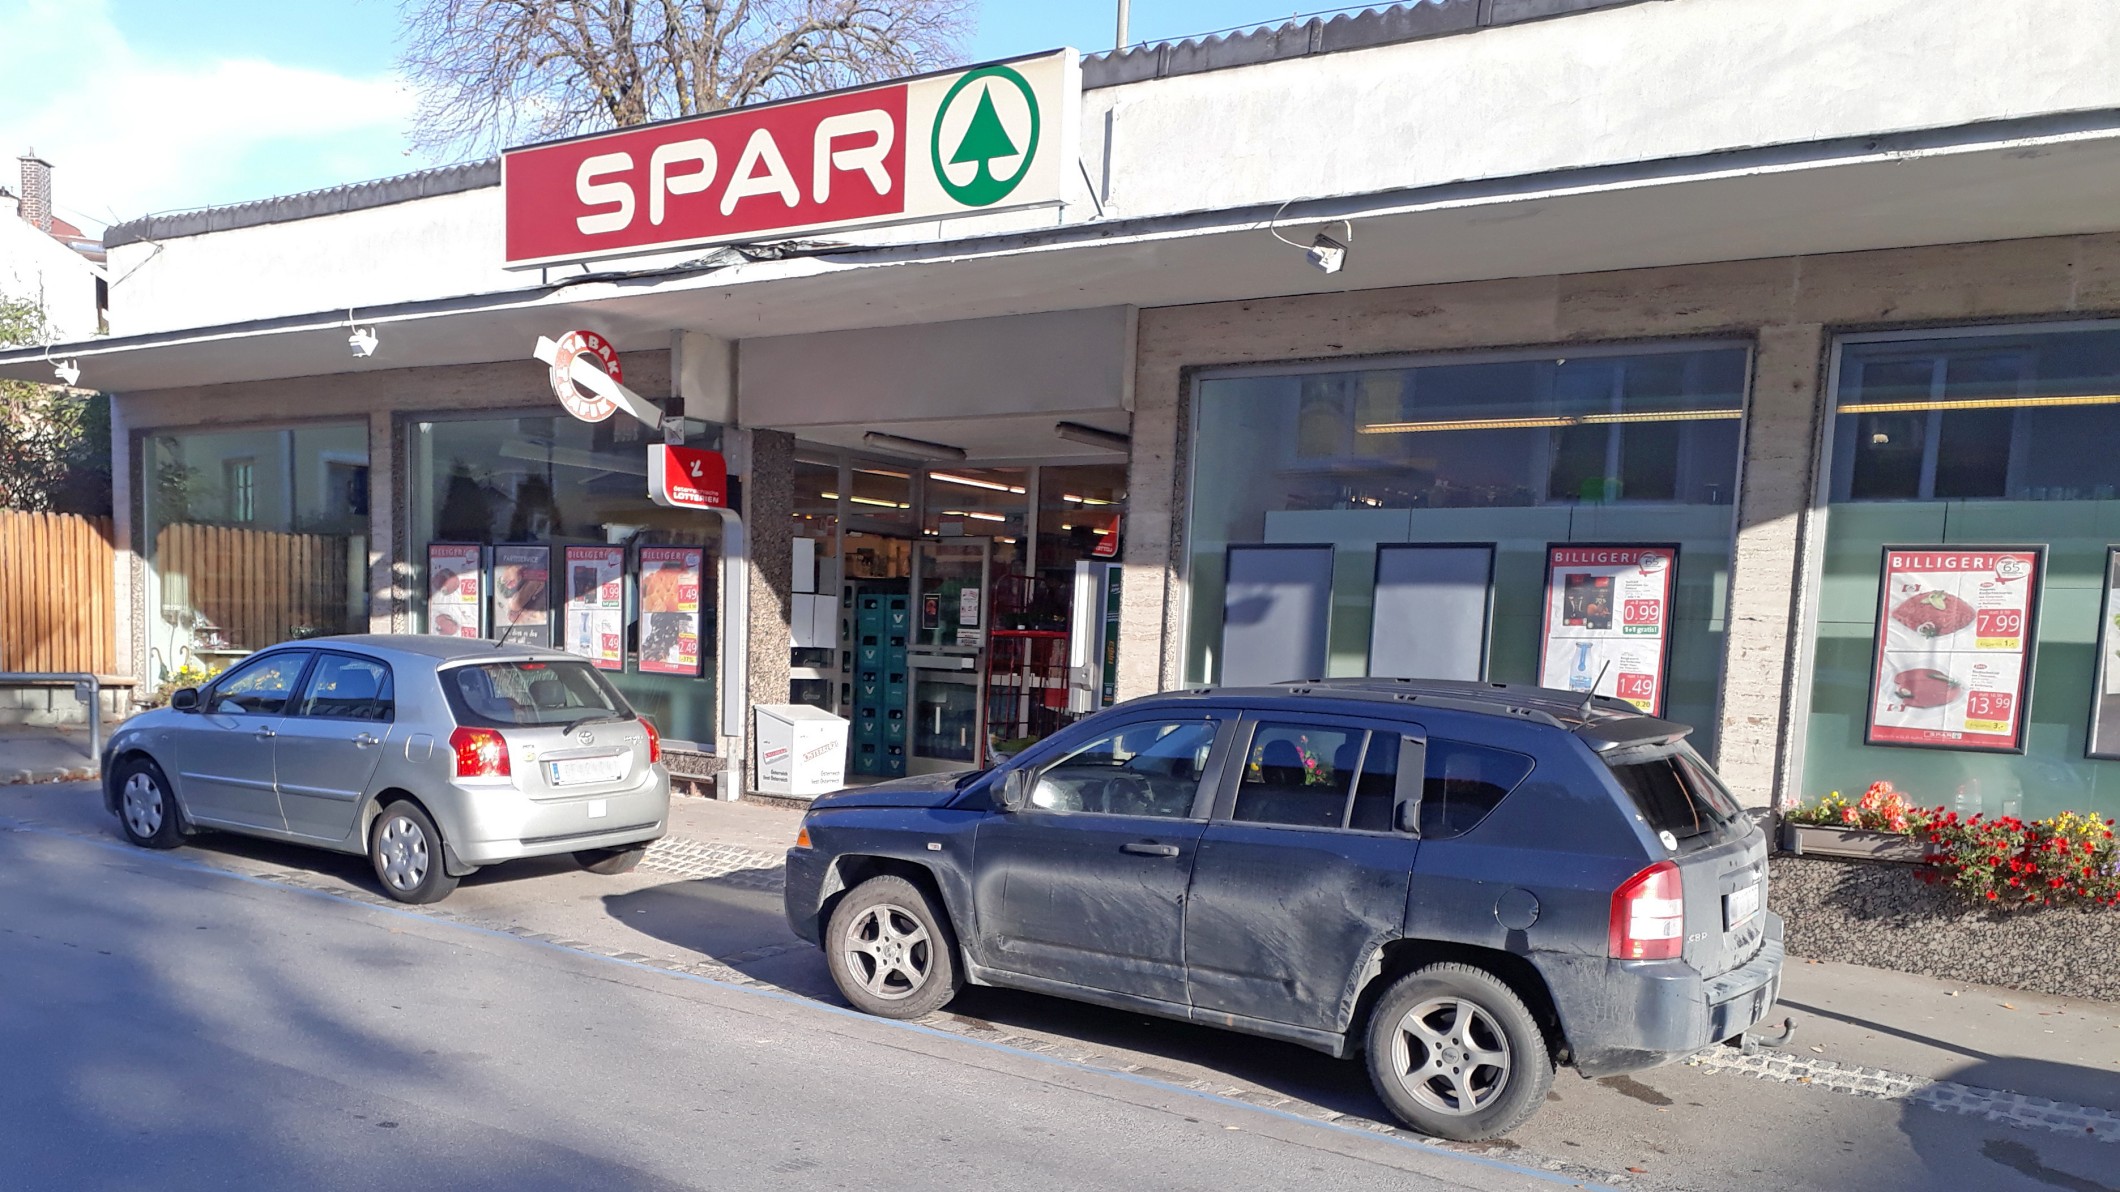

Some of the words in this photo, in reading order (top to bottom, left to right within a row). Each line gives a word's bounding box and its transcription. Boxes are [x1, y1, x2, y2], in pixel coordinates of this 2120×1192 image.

[575, 109, 895, 236] SPAR
[562, 335, 620, 375] TABAK
[556, 366, 612, 417] TRAFIK
[673, 492, 719, 504] LOTTERIEN
[431, 548, 466, 557] BILLIGER!
[567, 551, 607, 560] BILLIGER!
[643, 552, 685, 560] BILLIGER!
[1555, 552, 1638, 563] BILLIGER!
[1892, 557, 1993, 569] BILLIGER!
[2003, 563, 2020, 572] 65
[602, 587, 619, 598] 0.99
[679, 588, 697, 600] 1.49
[1625, 605, 1659, 621] 0.99
[1979, 615, 2020, 632] 7.99
[1637, 626, 1657, 634] gratis!
[603, 637, 619, 649] 1.49
[679, 641, 697, 654] 2.49
[1620, 678, 1652, 695] 1.49
[1970, 696, 2010, 714] 13.99
